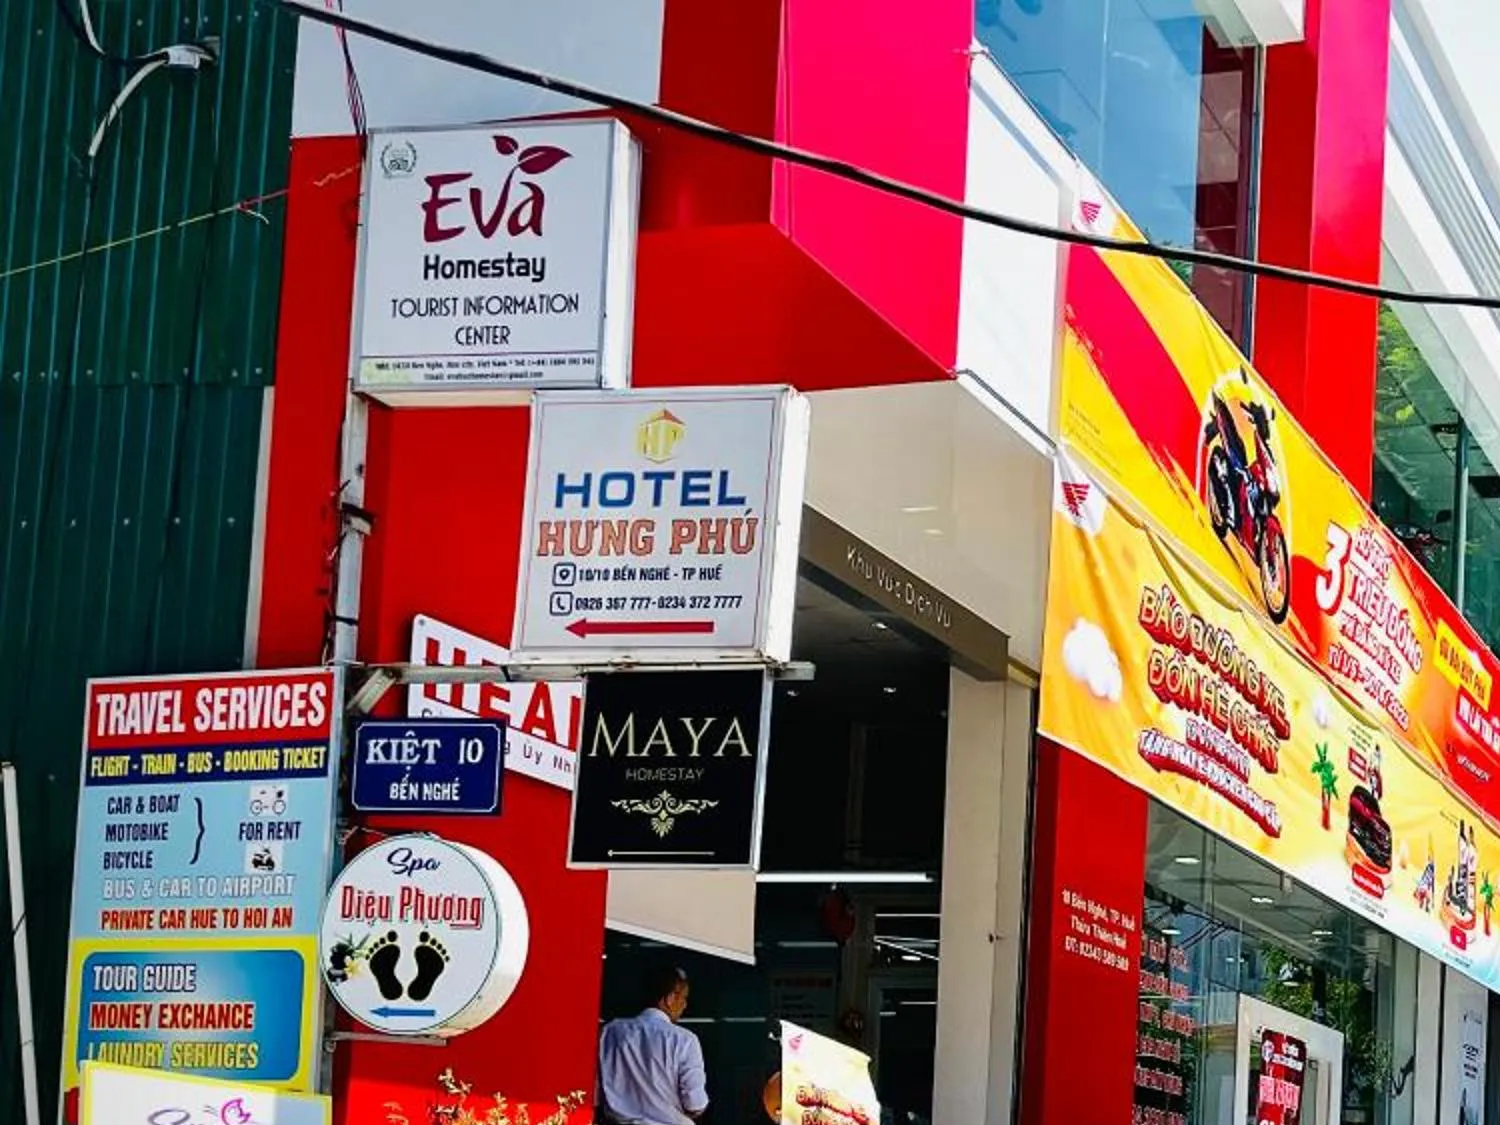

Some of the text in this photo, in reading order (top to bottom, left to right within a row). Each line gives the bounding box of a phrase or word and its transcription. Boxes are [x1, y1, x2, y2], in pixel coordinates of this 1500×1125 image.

[421, 167, 546, 243] Eva
[423, 252, 546, 283] Homestay
[391, 293, 579, 318] TOURIST INFORMATION
[455, 325, 511, 346] CENTER
[555, 470, 747, 508] HOTEL
[536, 508, 758, 556] HƯNG PHÚ
[578, 568, 609, 581] 10/10
[681, 567, 696, 580] TP
[1315, 519, 1351, 616] 3
[688, 595, 711, 609] 372
[713, 595, 743, 609] 7777
[97, 681, 328, 737] TRAVEL SERVICES
[587, 712, 752, 757] MAYA
[91, 747, 327, 777] FLIGHT TRAIN BUS BOOKING TICKET
[365, 731, 442, 770] KIỆT
[458, 737, 484, 765] 10
[388, 772, 461, 801] BẾN NGHÉ
[625, 768, 705, 781] HOMESTAY
[107, 796, 132, 815] CAR
[149, 794, 180, 813] BOAT
[105, 823, 169, 842] MOTOBIKE
[238, 821, 301, 841] FOR RENT
[103, 851, 153, 870] BICYCLE
[387, 847, 441, 877] Spa
[103, 879, 135, 899] BUS
[158, 877, 191, 898] CAR
[196, 876, 216, 897] TO
[221, 874, 296, 897] AIRPORT
[101, 907, 293, 931] PRIVATE CAR HUE TO HOI AN
[341, 885, 392, 926] Diệu
[93, 964, 197, 992] TOUR GUIDE
[90, 1003, 153, 1030] MONEY
[172, 1042, 259, 1069] SERVICES
